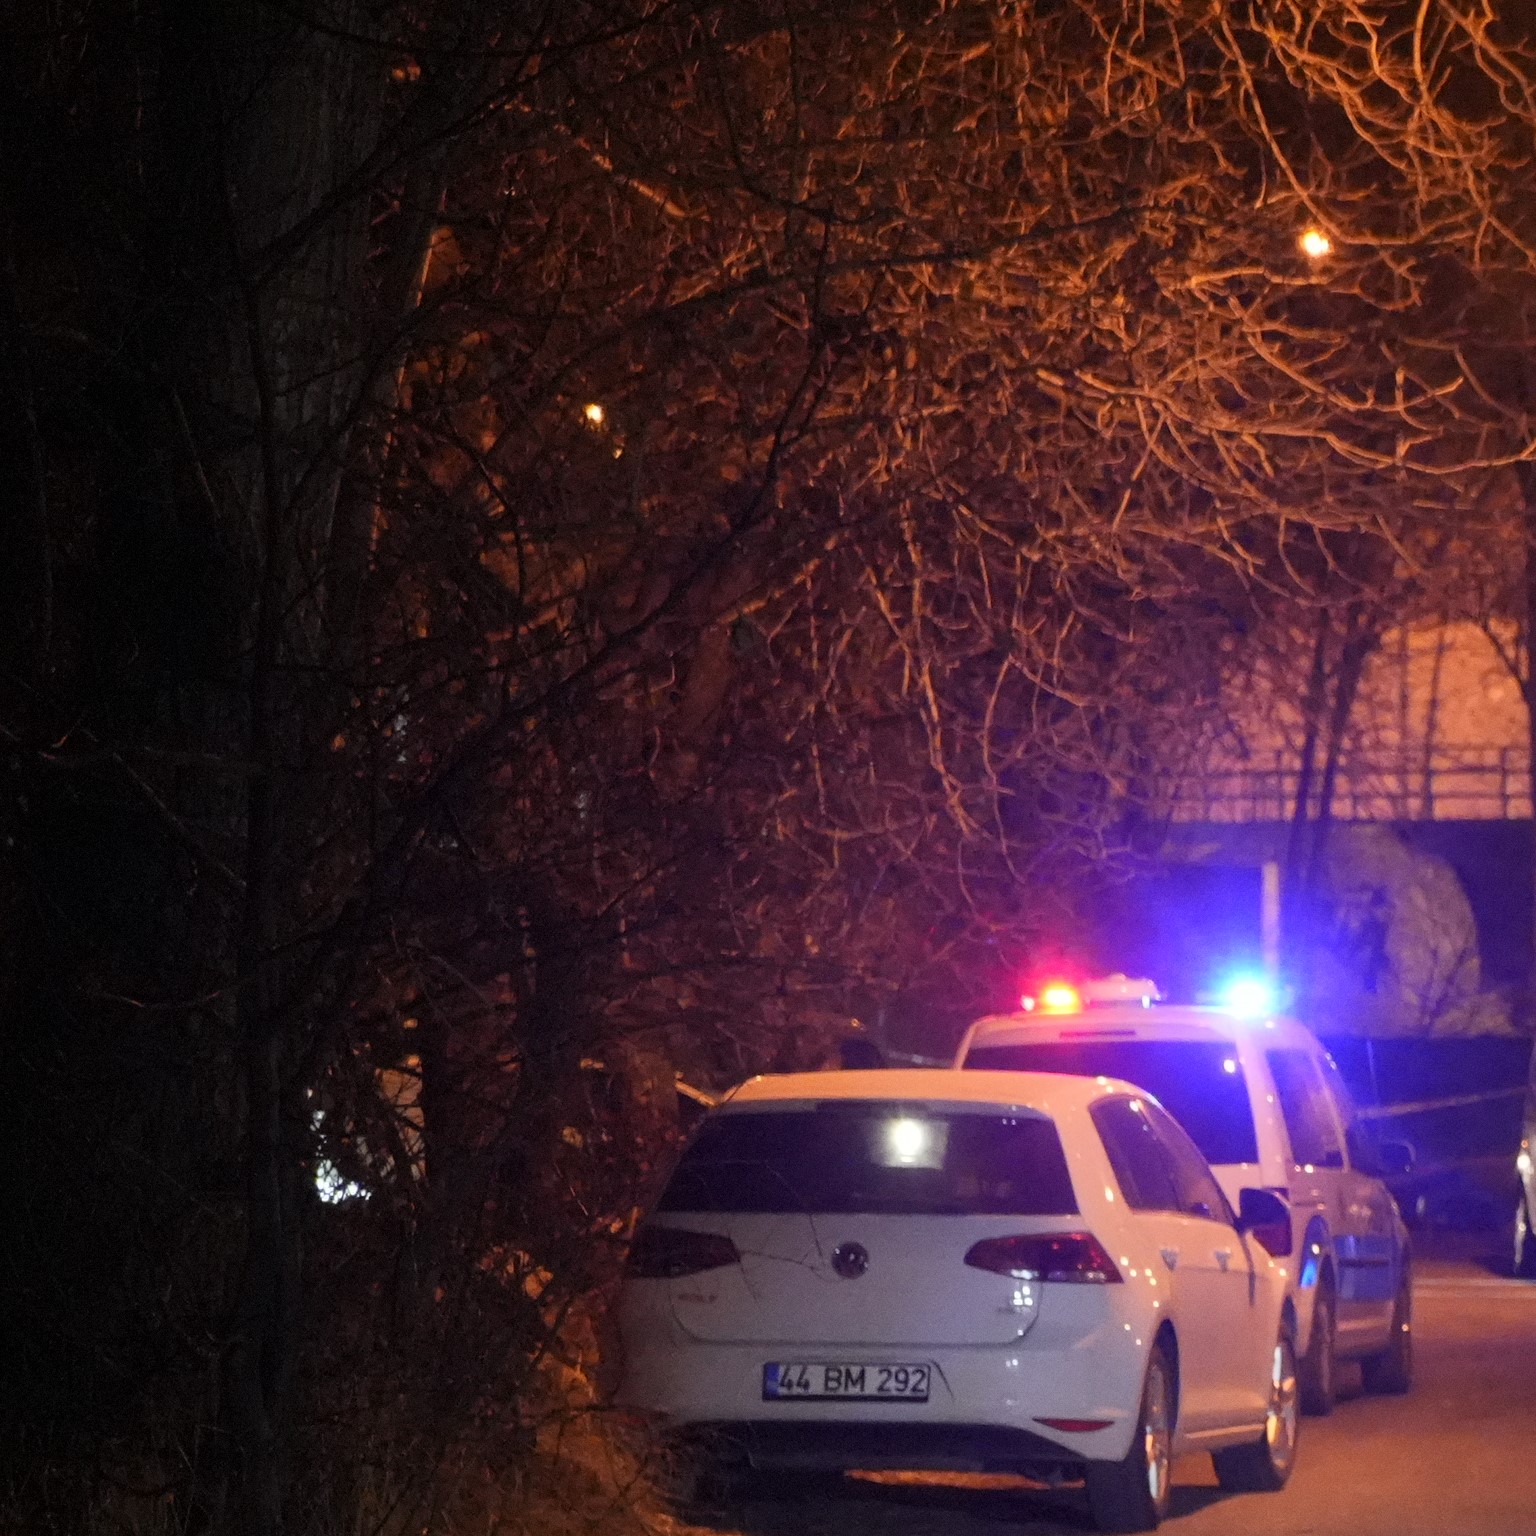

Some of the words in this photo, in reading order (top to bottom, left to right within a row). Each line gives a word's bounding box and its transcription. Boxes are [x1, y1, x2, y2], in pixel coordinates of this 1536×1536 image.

[779, 1364, 811, 1391] 44
[824, 1366, 866, 1392] BM
[877, 1368, 927, 1393] 292
